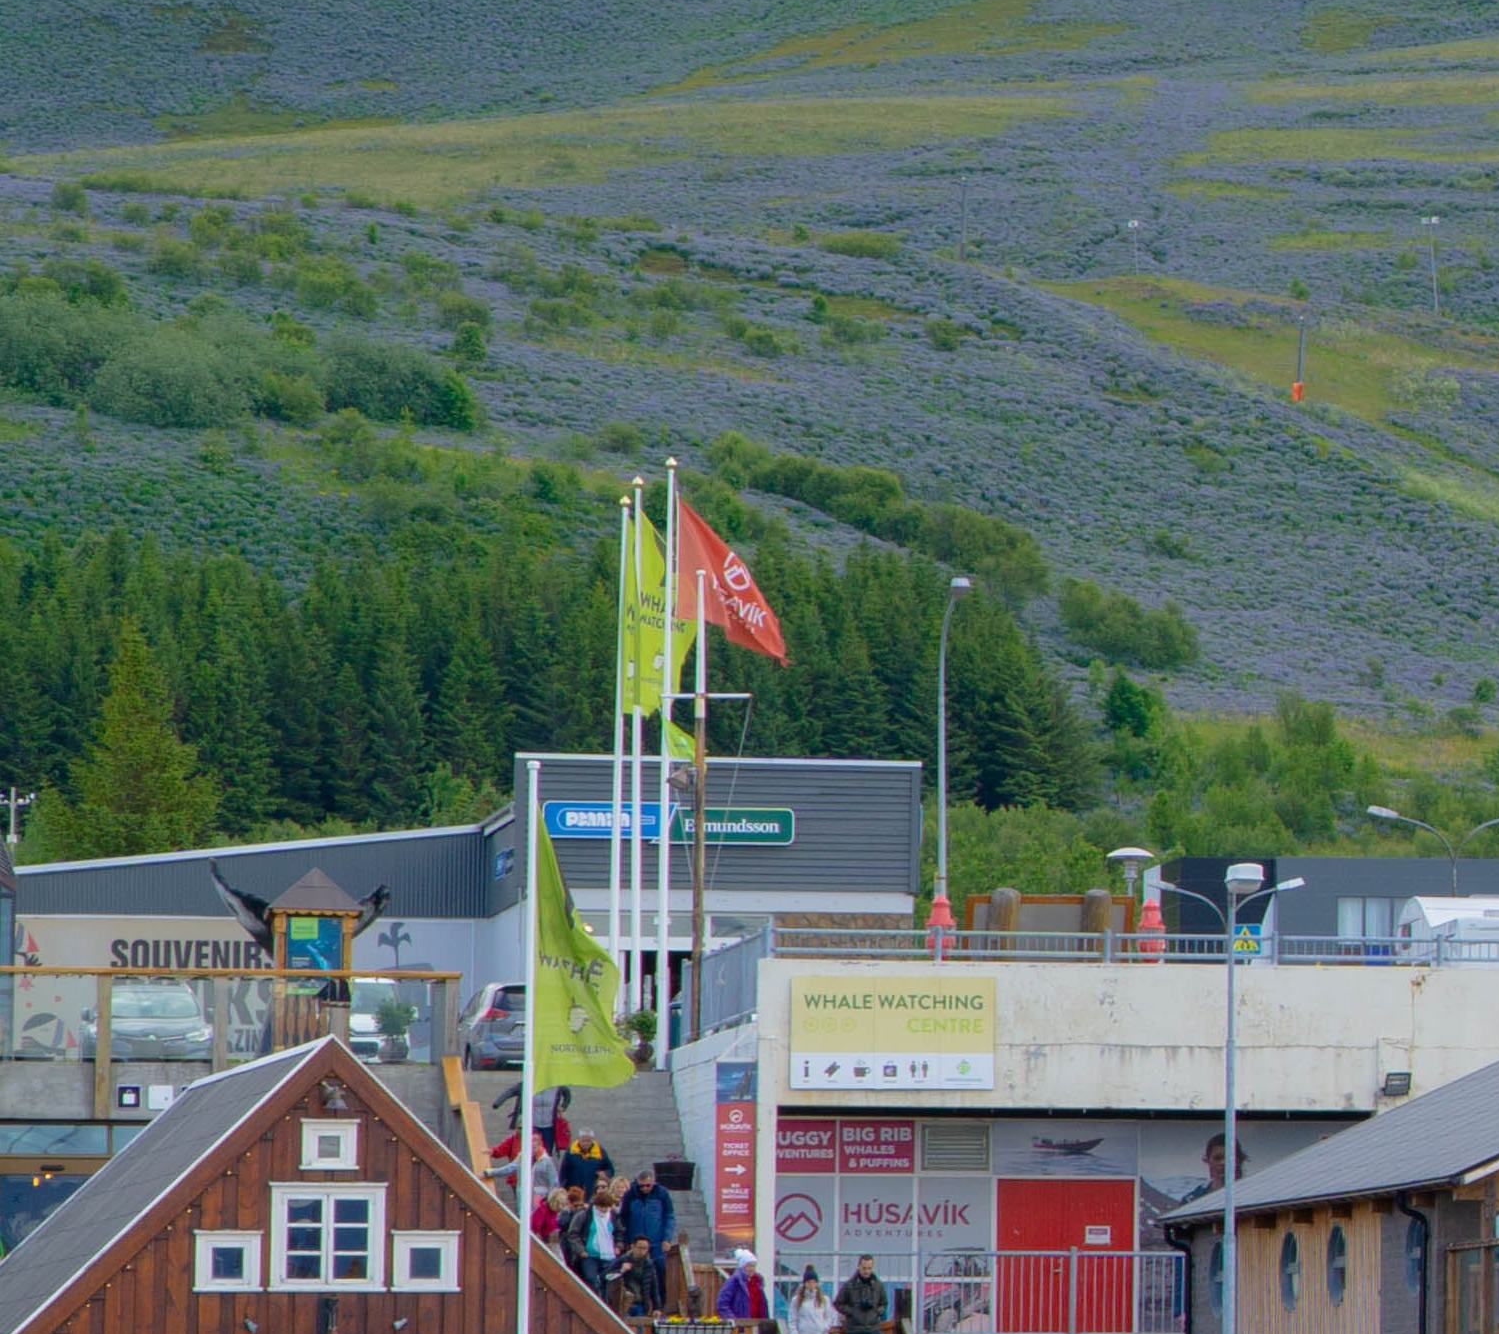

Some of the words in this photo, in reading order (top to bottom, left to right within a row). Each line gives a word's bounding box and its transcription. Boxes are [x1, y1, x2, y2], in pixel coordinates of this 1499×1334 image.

[685, 818, 780, 833] Emundsson
[804, 994, 873, 1010] WHALE
[878, 994, 984, 1010] WATCHING
[906, 1018, 983, 1033] CENTRE
[778, 1130, 833, 1145] UGGY
[842, 1127, 874, 1142] BIG
[880, 1127, 912, 1142] RIB
[777, 1148, 834, 1159] VENTURES
[844, 1145, 895, 1155] WHALES
[859, 1157, 910, 1168] PUFFINS
[844, 1198, 970, 1226] HÚSAVÍK
